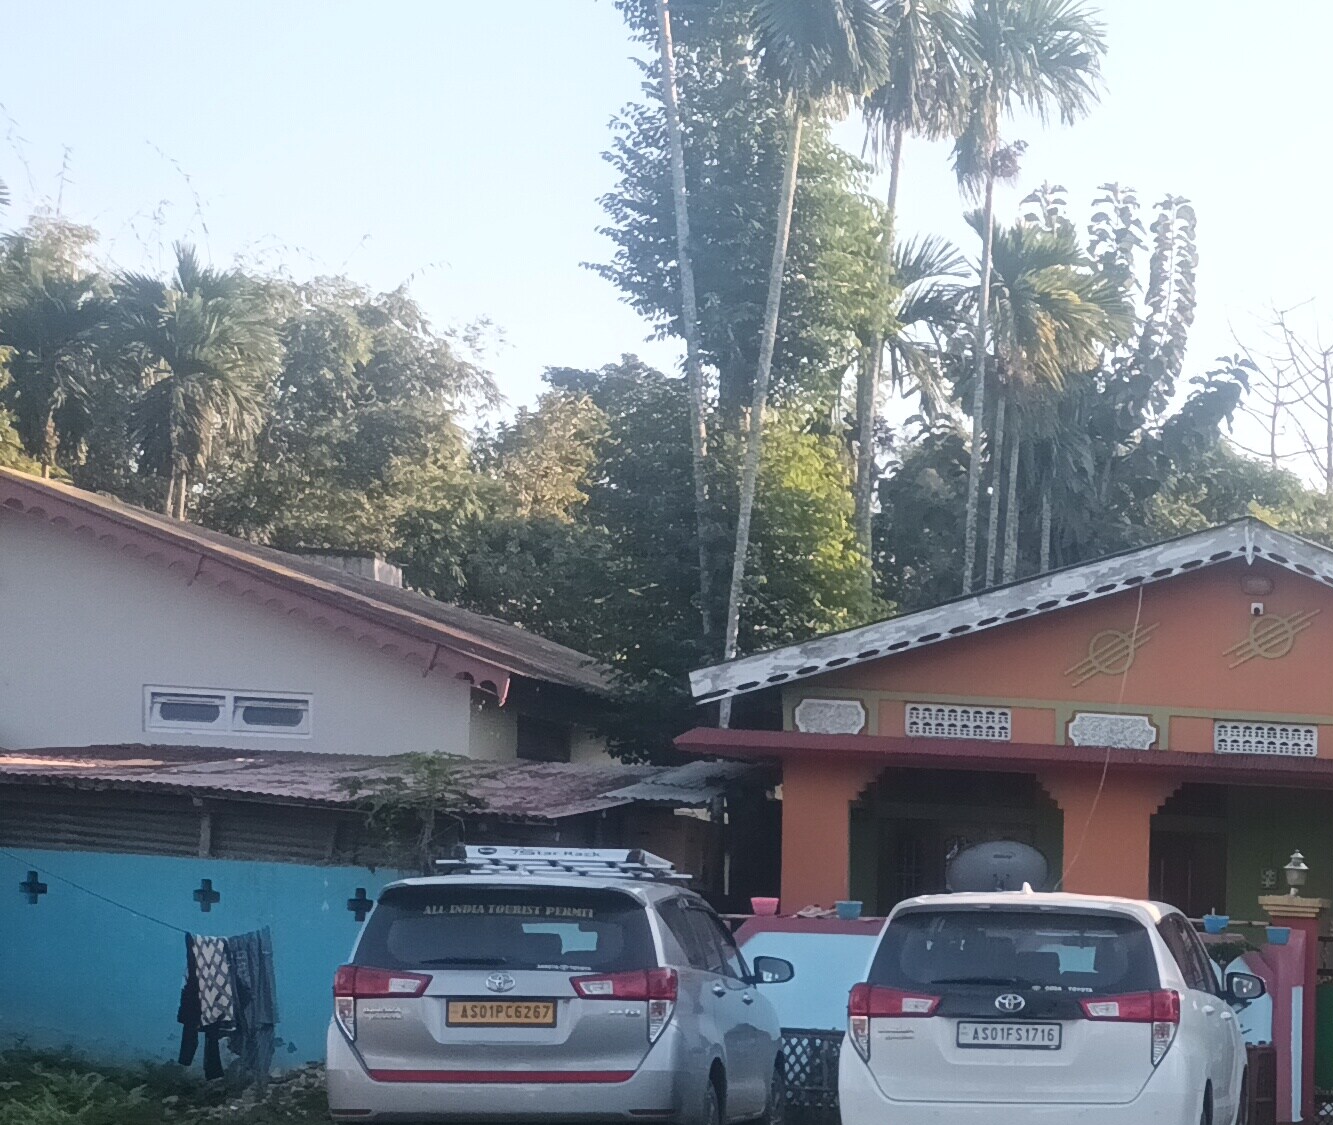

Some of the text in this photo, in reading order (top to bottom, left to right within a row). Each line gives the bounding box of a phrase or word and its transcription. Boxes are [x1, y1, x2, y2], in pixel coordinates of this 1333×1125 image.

[423, 905, 593, 918] ALL INDIA TOURIST PERMIT
[460, 1004, 550, 1020] AS01PC6267
[972, 1027, 1055, 1042] AS01FS1716
